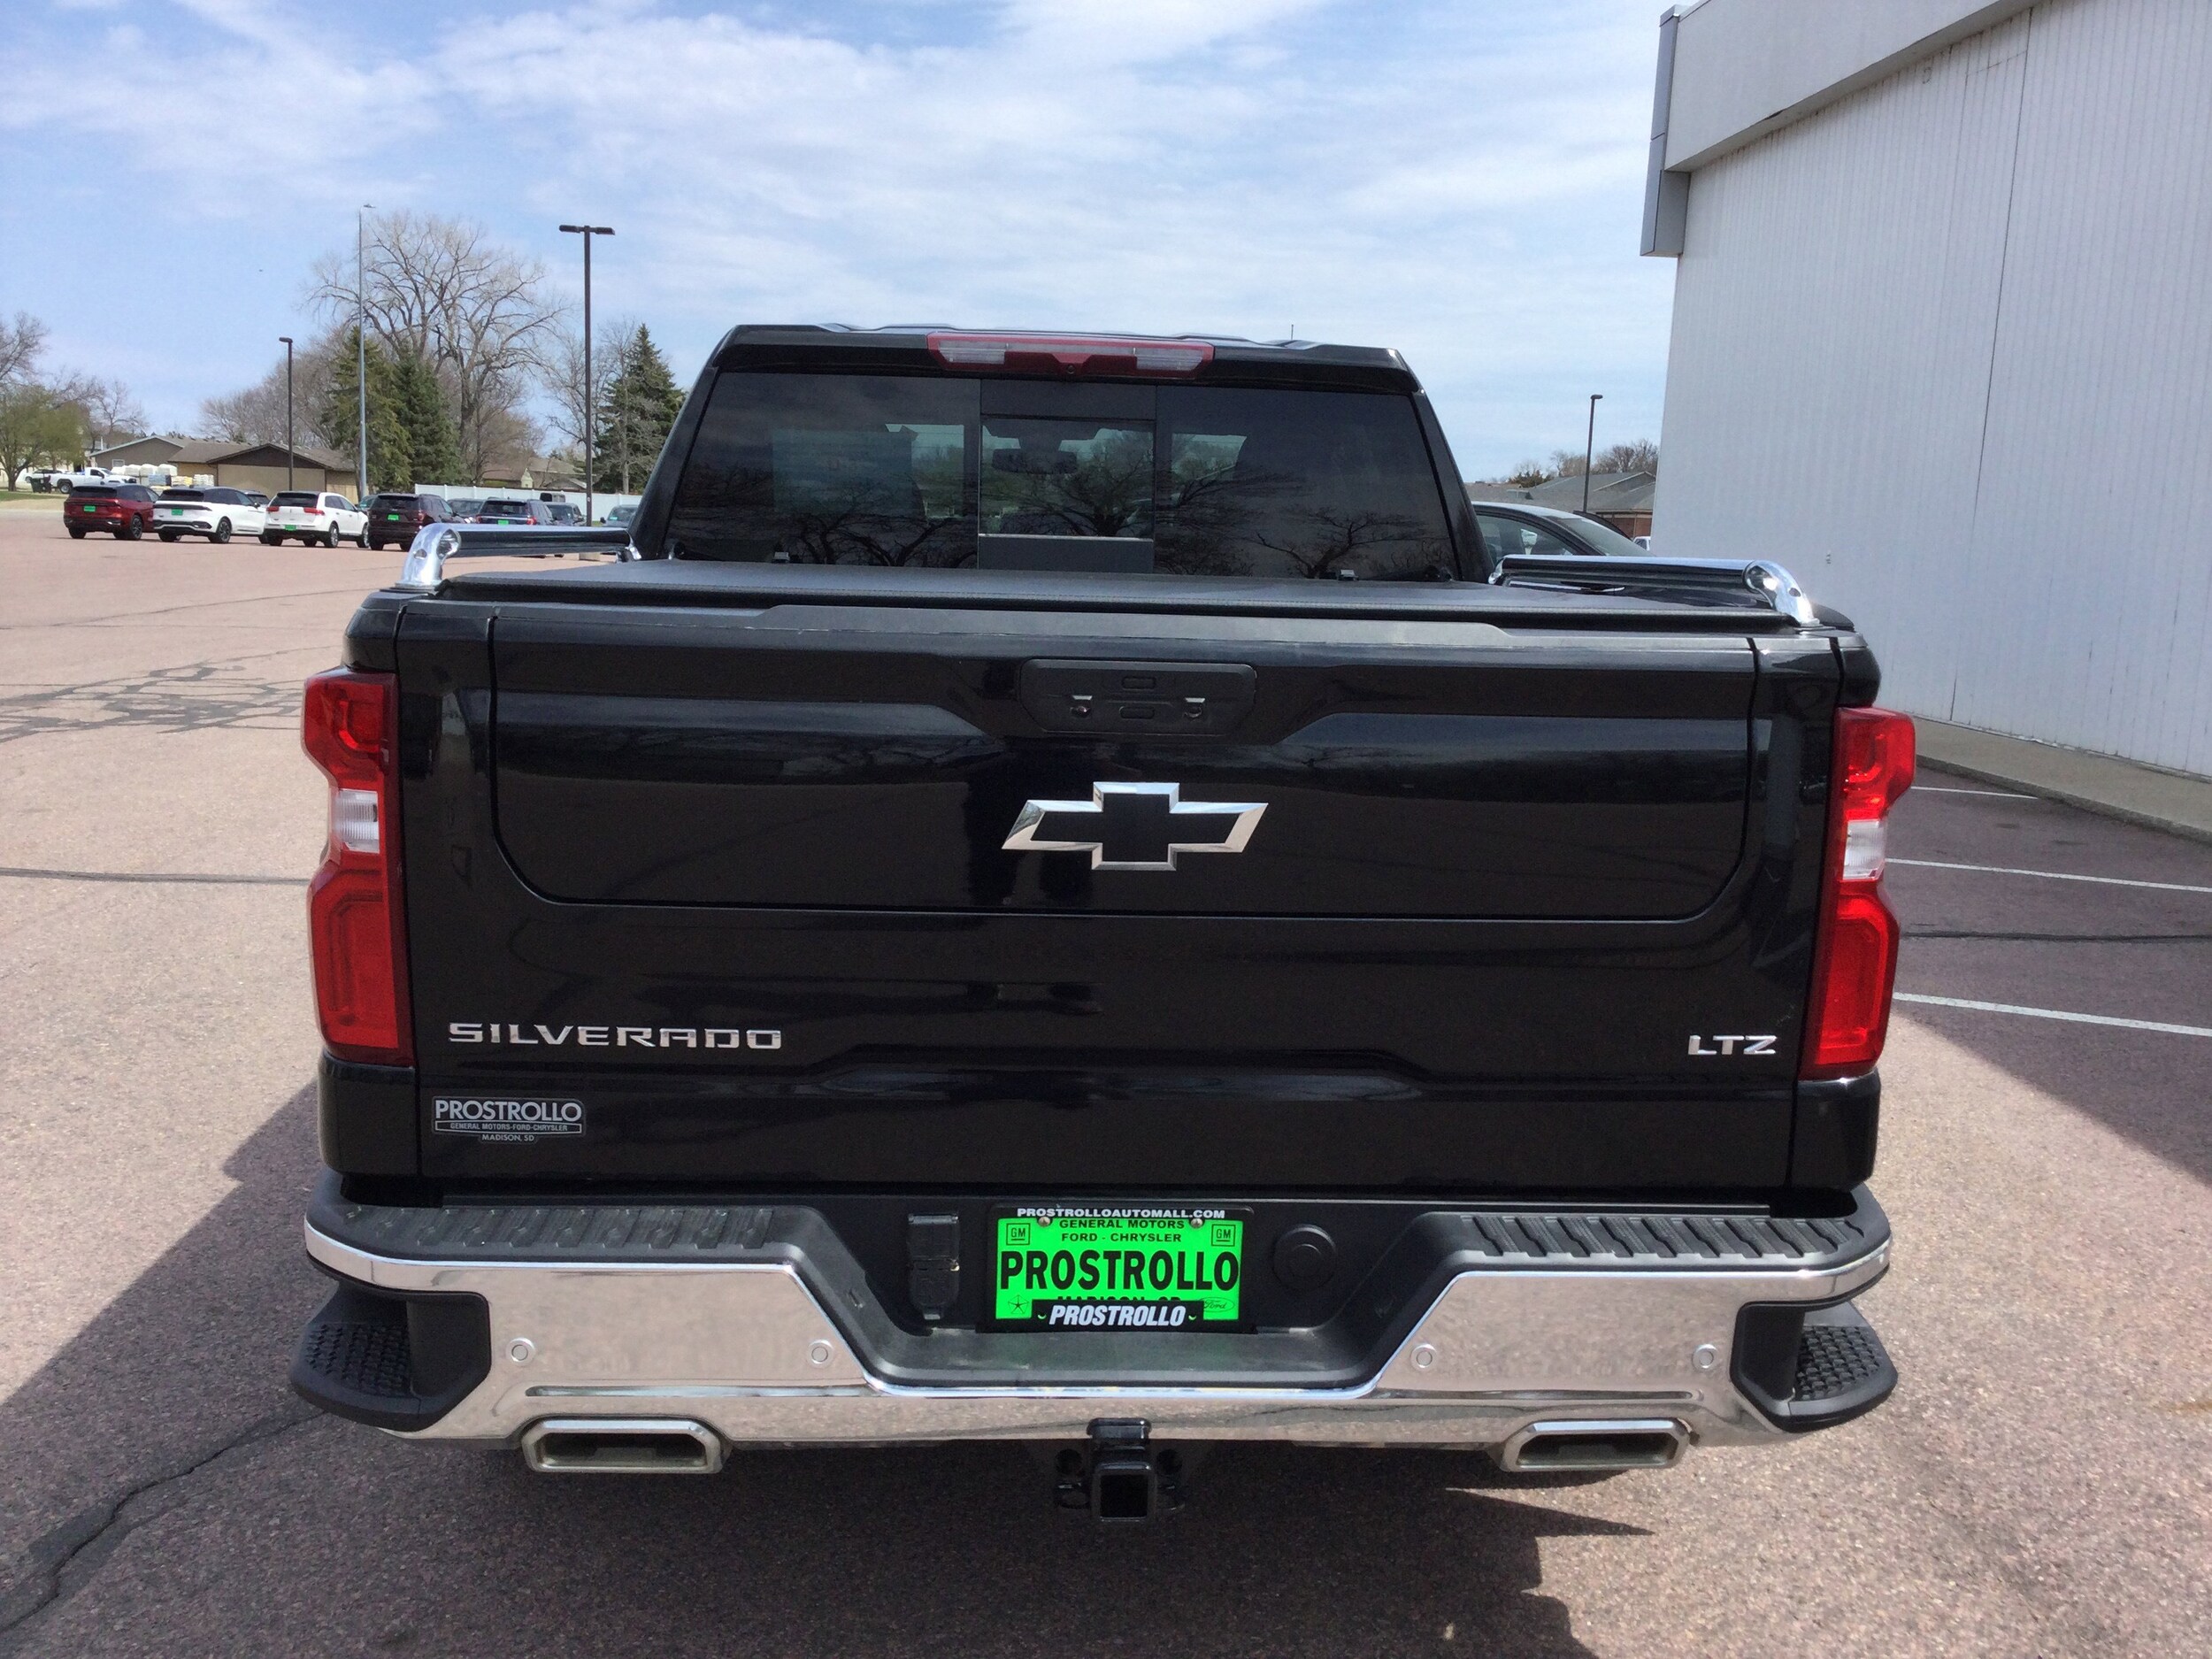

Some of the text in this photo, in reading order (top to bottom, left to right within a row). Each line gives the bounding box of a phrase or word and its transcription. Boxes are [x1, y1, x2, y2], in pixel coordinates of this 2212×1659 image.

[449, 1023, 781, 1049] SILVERADO
[1687, 1034, 1778, 1056] LTZ
[434, 1100, 582, 1122] PROSTROLLO
[1017, 1208, 1225, 1219] PROSTROLLOAUTOMALL.COM
[1010, 1227, 1026, 1238] GM
[1059, 1219, 1185, 1229] GENERAL MOTORS
[1062, 1233, 1098, 1241] FORD
[1110, 1233, 1182, 1242] CHRYSLER
[1216, 1228, 1232, 1240] GM
[1000, 1249, 1240, 1291] PROSTROLLO
[1048, 1304, 1187, 1326] PROSTROLLO
